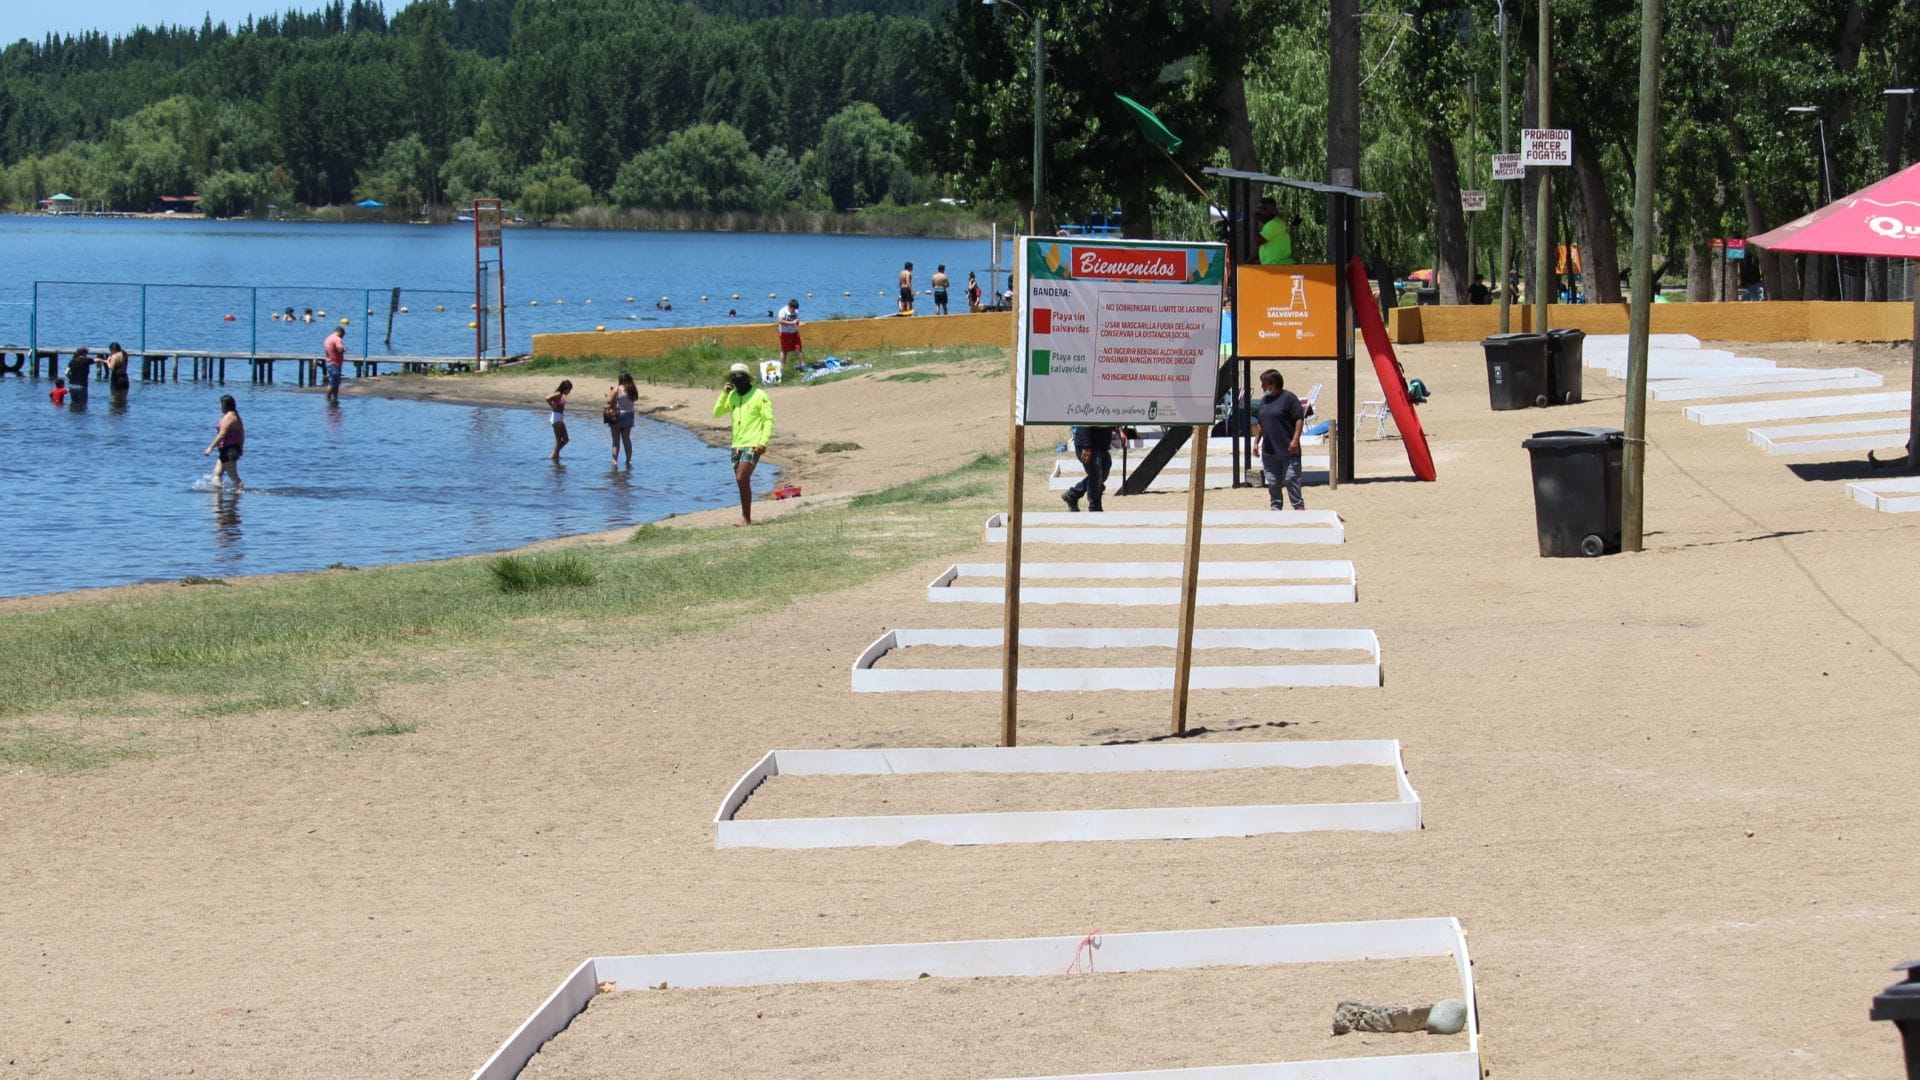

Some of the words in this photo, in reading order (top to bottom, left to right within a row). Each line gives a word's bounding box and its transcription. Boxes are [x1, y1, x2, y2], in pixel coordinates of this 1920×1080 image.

[1524, 130, 1568, 140] PROHIBIDO
[1532, 141, 1561, 150] HACER
[1526, 151, 1567, 160] FOGATAS
[1495, 168, 1524, 176] MASCOTAS
[1080, 252, 1176, 276] Bienvenidos
[1033, 287, 1071, 297] BANDERA:
[1116, 304, 1151, 312] SOBREPASAR
[1052, 312, 1072, 323] Playa
[1074, 312, 1085, 320] sin
[1052, 324, 1090, 333] salvavidas
[1052, 352, 1071, 363] Playa
[1050, 365, 1087, 374] salvavidas
